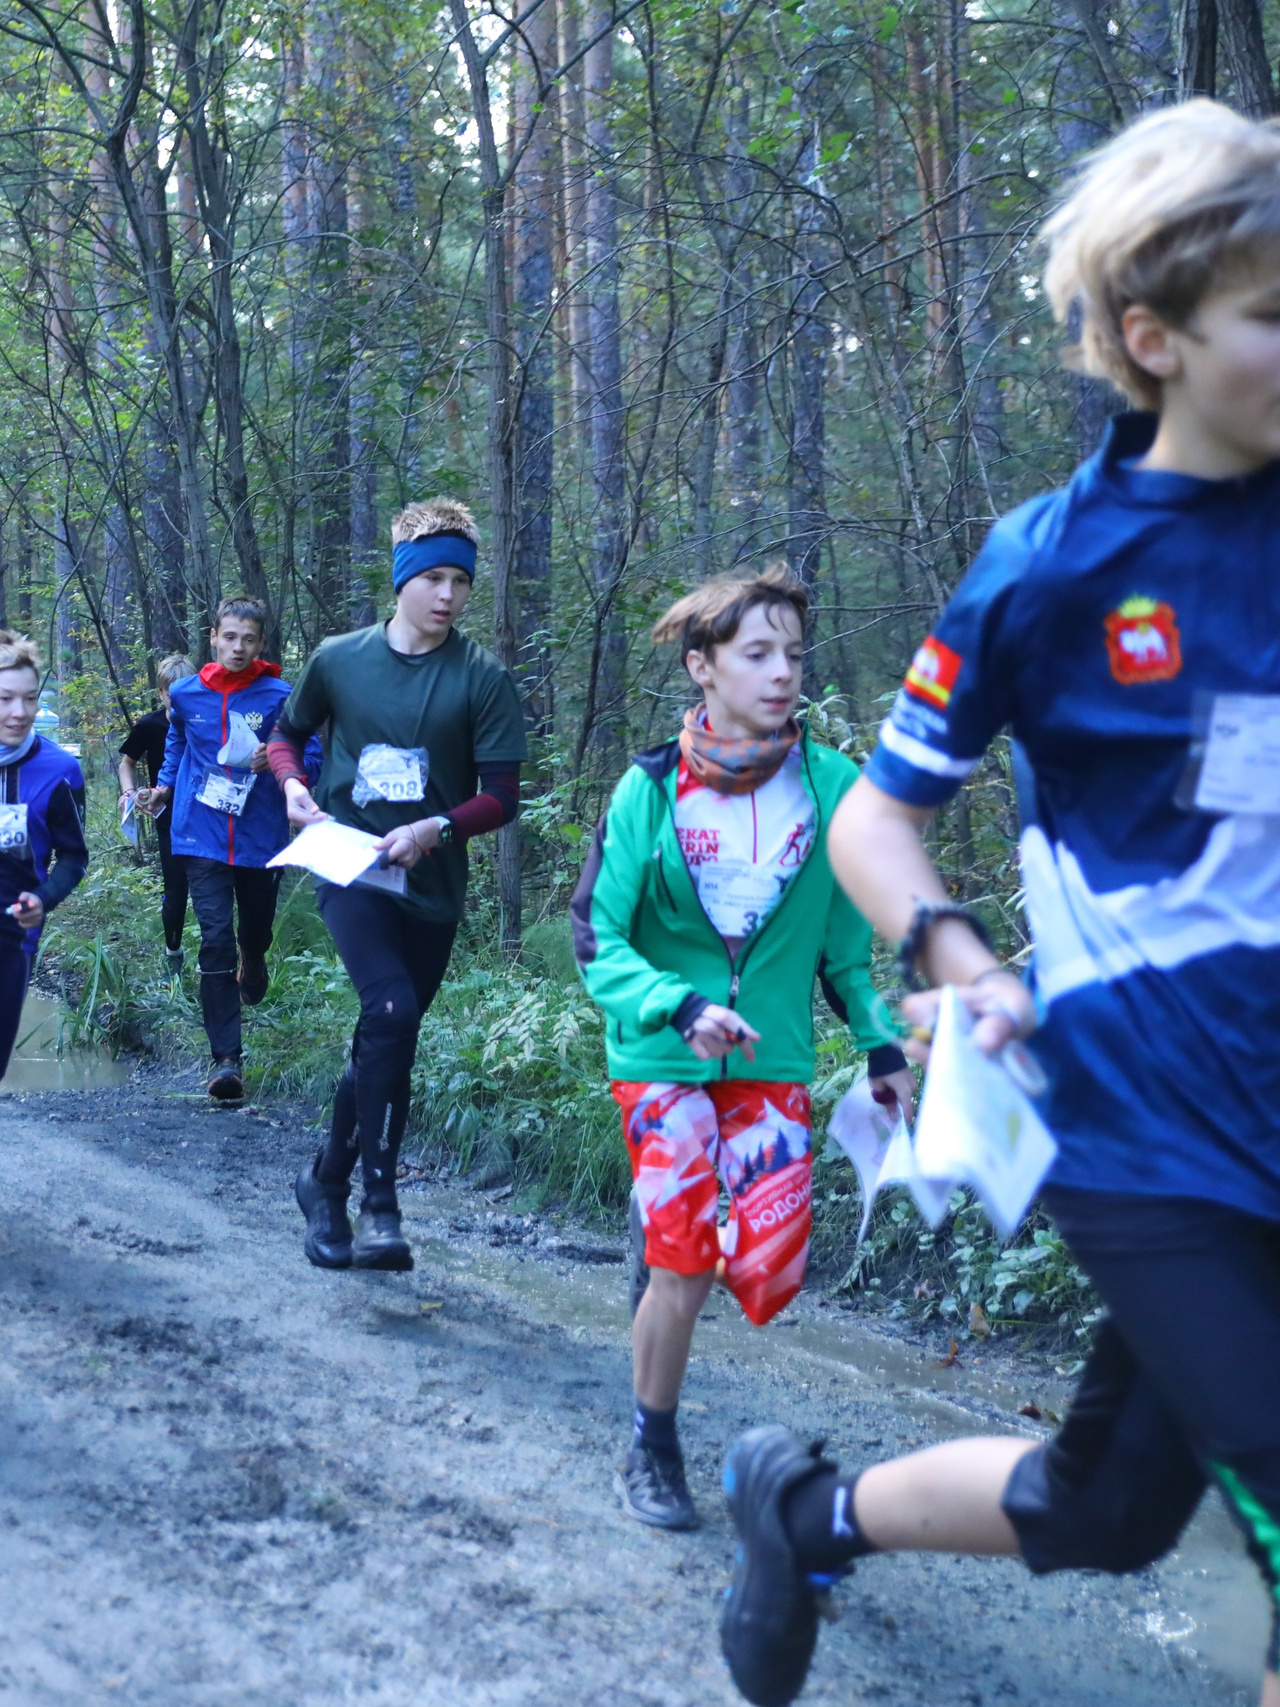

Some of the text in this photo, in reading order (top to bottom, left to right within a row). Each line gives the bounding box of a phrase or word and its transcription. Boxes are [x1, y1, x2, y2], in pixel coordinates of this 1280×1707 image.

[380, 780, 418, 799] 308
[216, 798, 241, 815] 332
[680, 841, 719, 854] RIN
